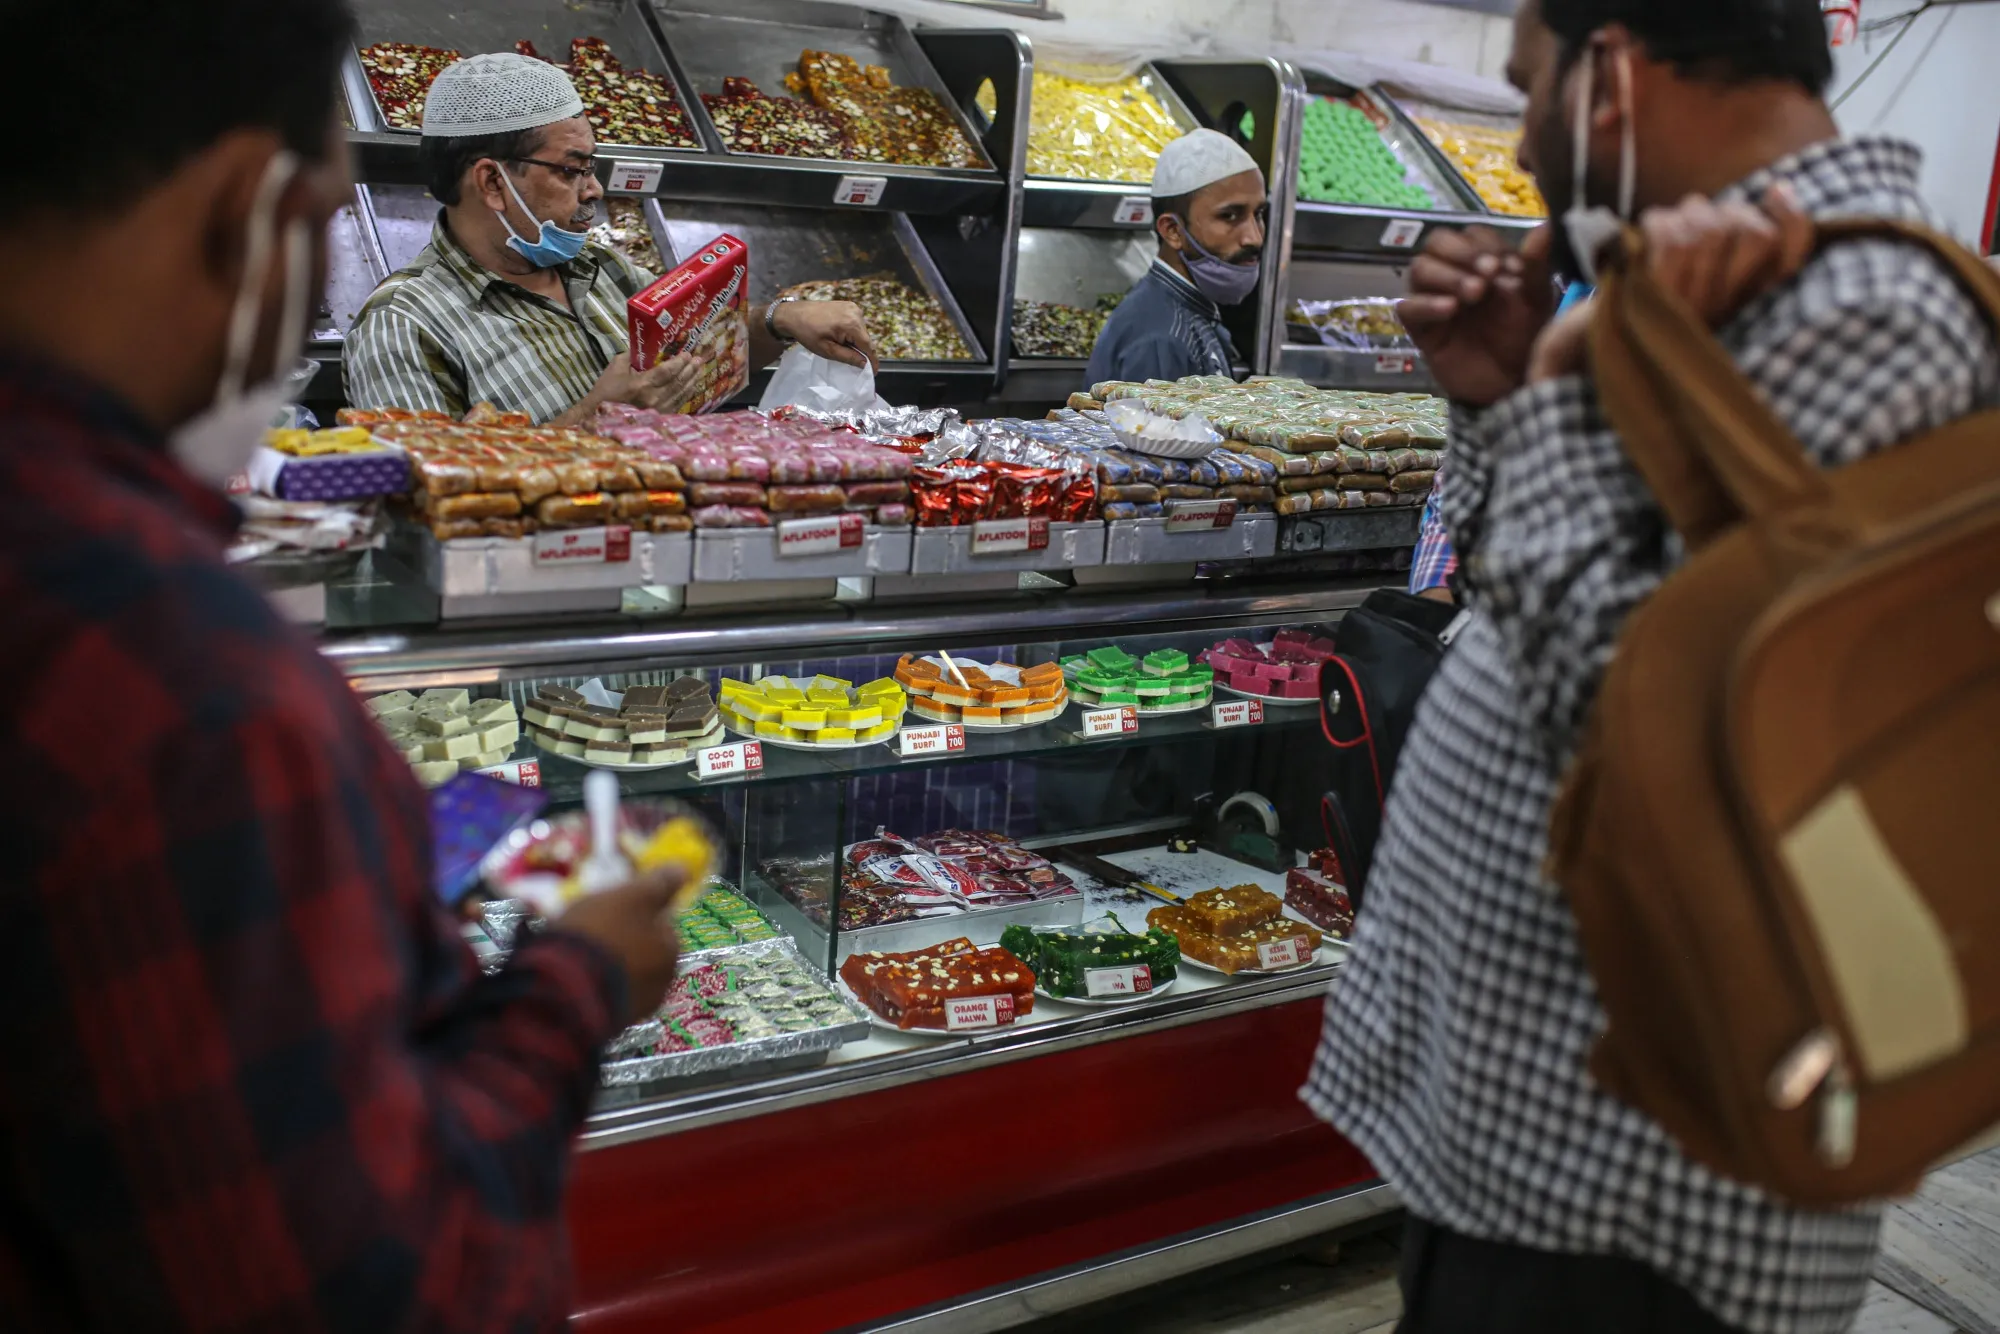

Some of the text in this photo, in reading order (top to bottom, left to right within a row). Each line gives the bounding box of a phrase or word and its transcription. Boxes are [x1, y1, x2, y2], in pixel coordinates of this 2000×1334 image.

[1171, 512, 1218, 522] AFLATOON
[783, 528, 838, 542] AFLATOON
[977, 530, 1026, 542] AFLATOON
[539, 547, 602, 559] AFLATOON
[1218, 705, 1245, 714] PUNJABI
[1249, 701, 1261, 710] Rs.
[1088, 713, 1117, 723] PUNJABI
[1122, 709, 1134, 718] Rs.
[1223, 714, 1241, 723] BURFI
[1249, 711, 1261, 721] 700
[1094, 722, 1113, 731] BURFI
[1123, 719, 1136, 729] 700
[906, 730, 941, 741] PUNJABI
[947, 726, 961, 736] Rs.
[912, 740, 935, 749] BURFI
[949, 736, 963, 748] 700
[708, 749, 735, 760] CO-CO
[744, 744, 759, 755] Rs.
[711, 760, 734, 771] BURFI
[746, 756, 761, 767] 720
[520, 763, 537, 775] Rs.
[521, 775, 539, 787] 720
[1269, 953, 1292, 964] HALWA
[1136, 979, 1150, 991] 500
[953, 1003, 989, 1014] ORANGE
[996, 998, 1012, 1010] Rs.
[957, 1013, 988, 1024] HALWA
[998, 1010, 1013, 1022] 500
